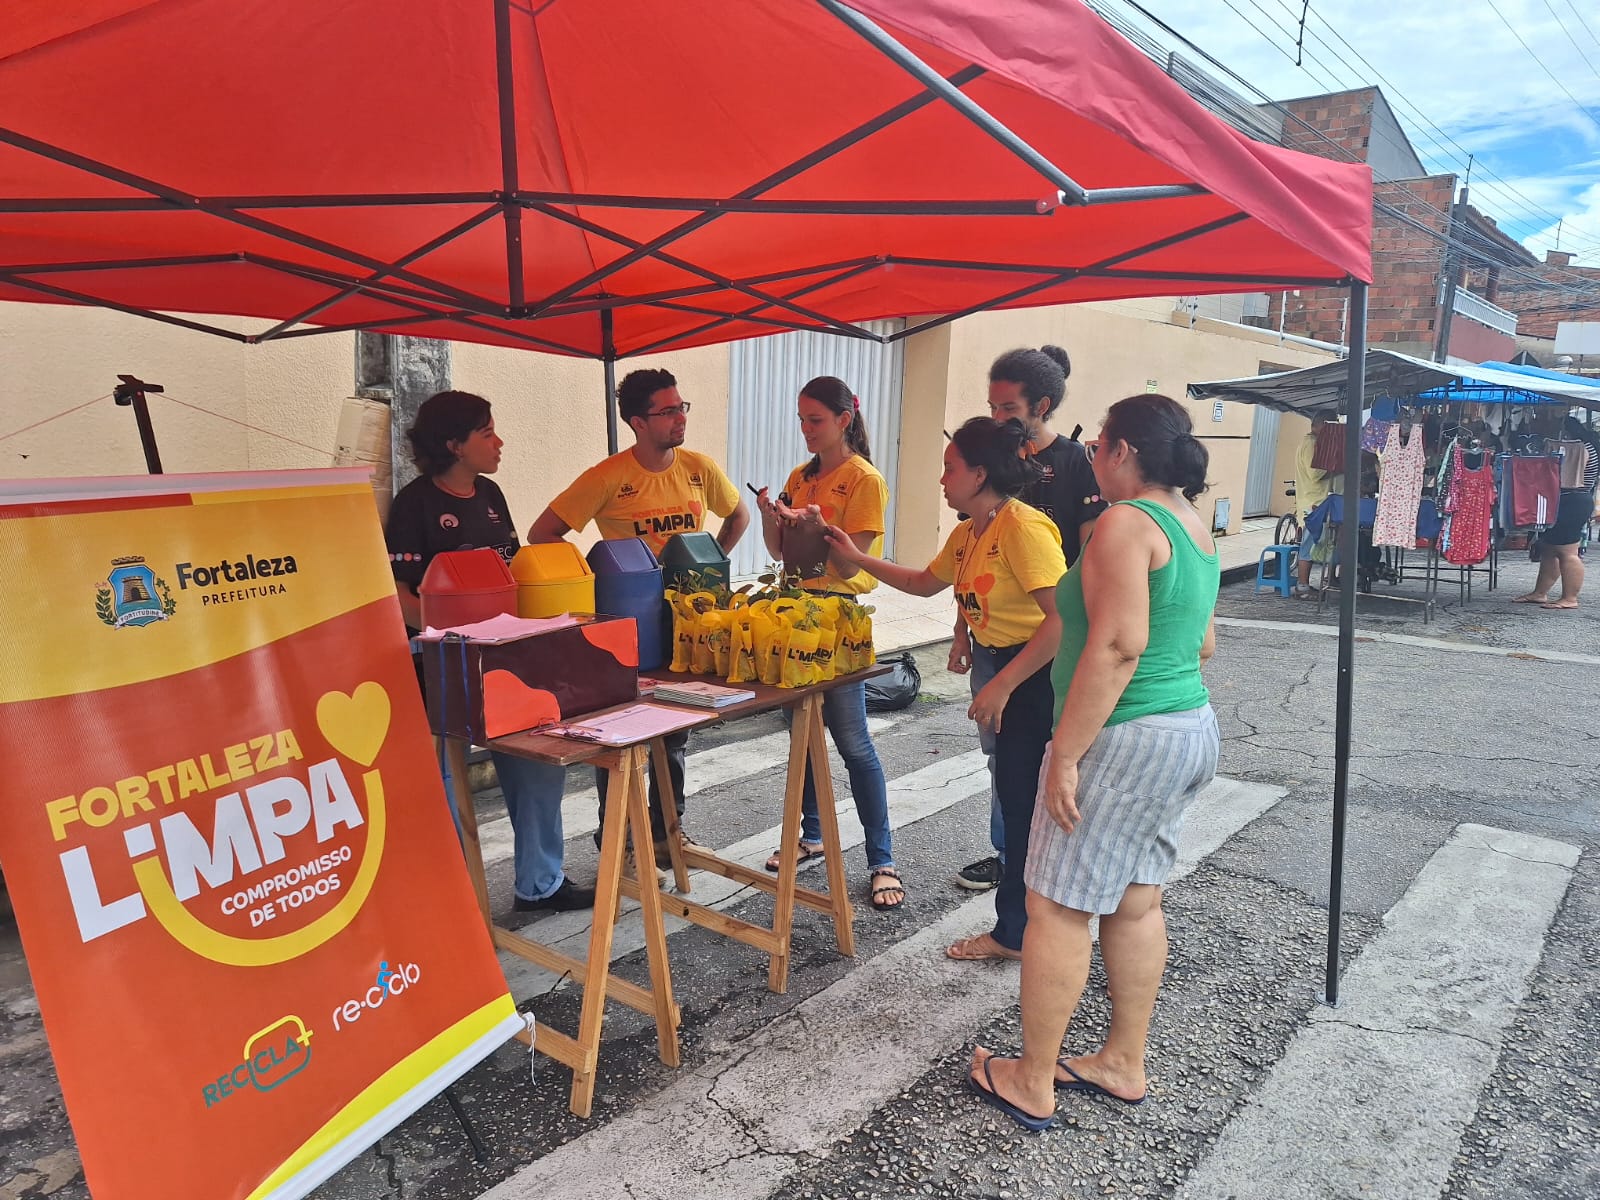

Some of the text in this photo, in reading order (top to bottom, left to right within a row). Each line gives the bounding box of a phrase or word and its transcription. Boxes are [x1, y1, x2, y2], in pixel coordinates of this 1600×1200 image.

[175, 553, 298, 590] Fortaleza
[202, 583, 287, 606] PREFEITURA
[46, 729, 304, 841] FORTALEZA
[220, 845, 352, 915] COMPROMISSO
[249, 873, 341, 928] DE TODOS
